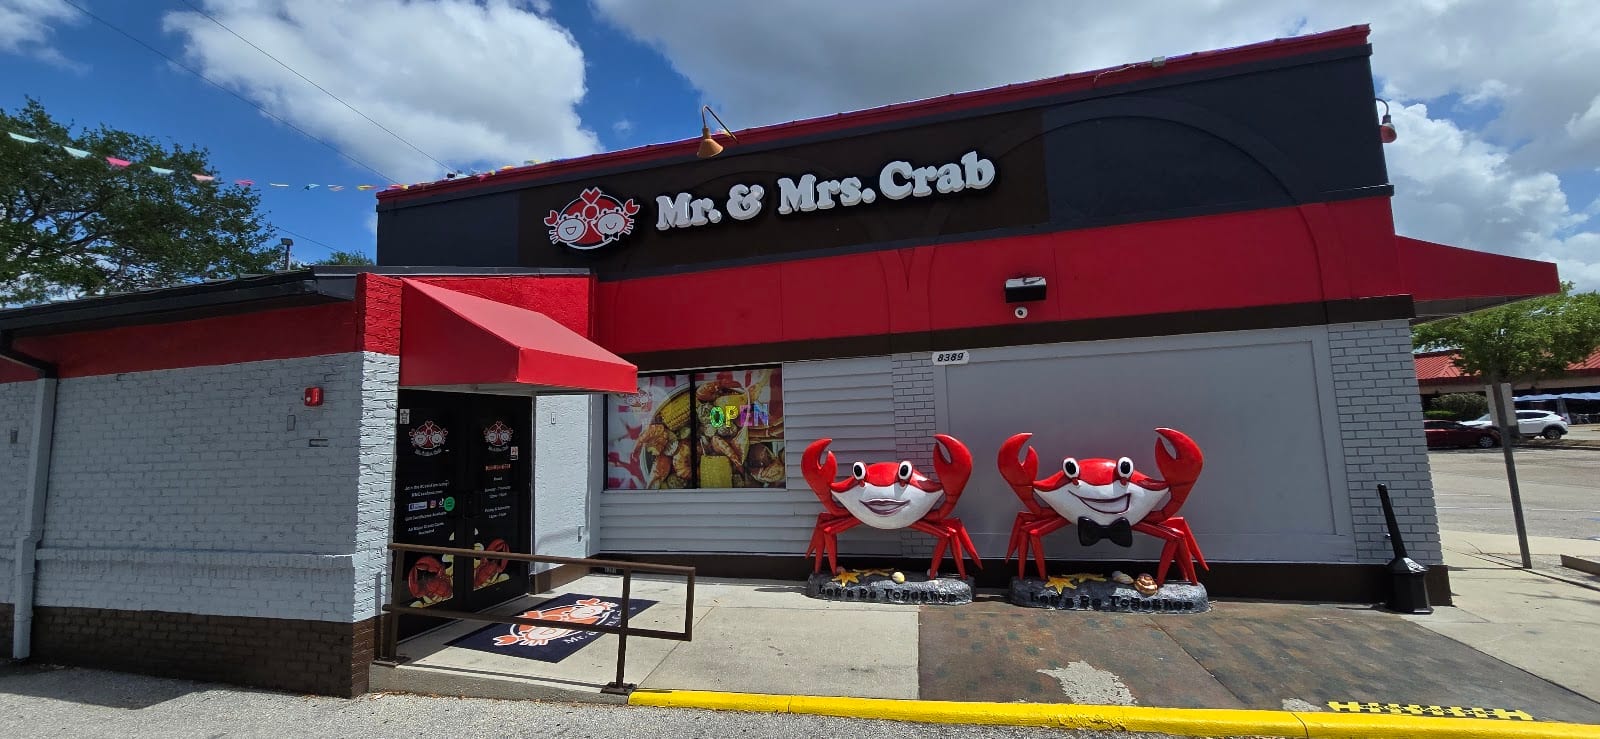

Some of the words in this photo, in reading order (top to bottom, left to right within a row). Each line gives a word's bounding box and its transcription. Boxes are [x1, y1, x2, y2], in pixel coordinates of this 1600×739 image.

[655, 192, 722, 231] Mr.
[726, 183, 764, 220] &
[776, 173, 876, 215] Mrs.
[879, 150, 996, 200] Crab
[937, 352, 964, 362] 8389
[709, 401, 769, 428] OPEN
[884, 588, 958, 602] Together
